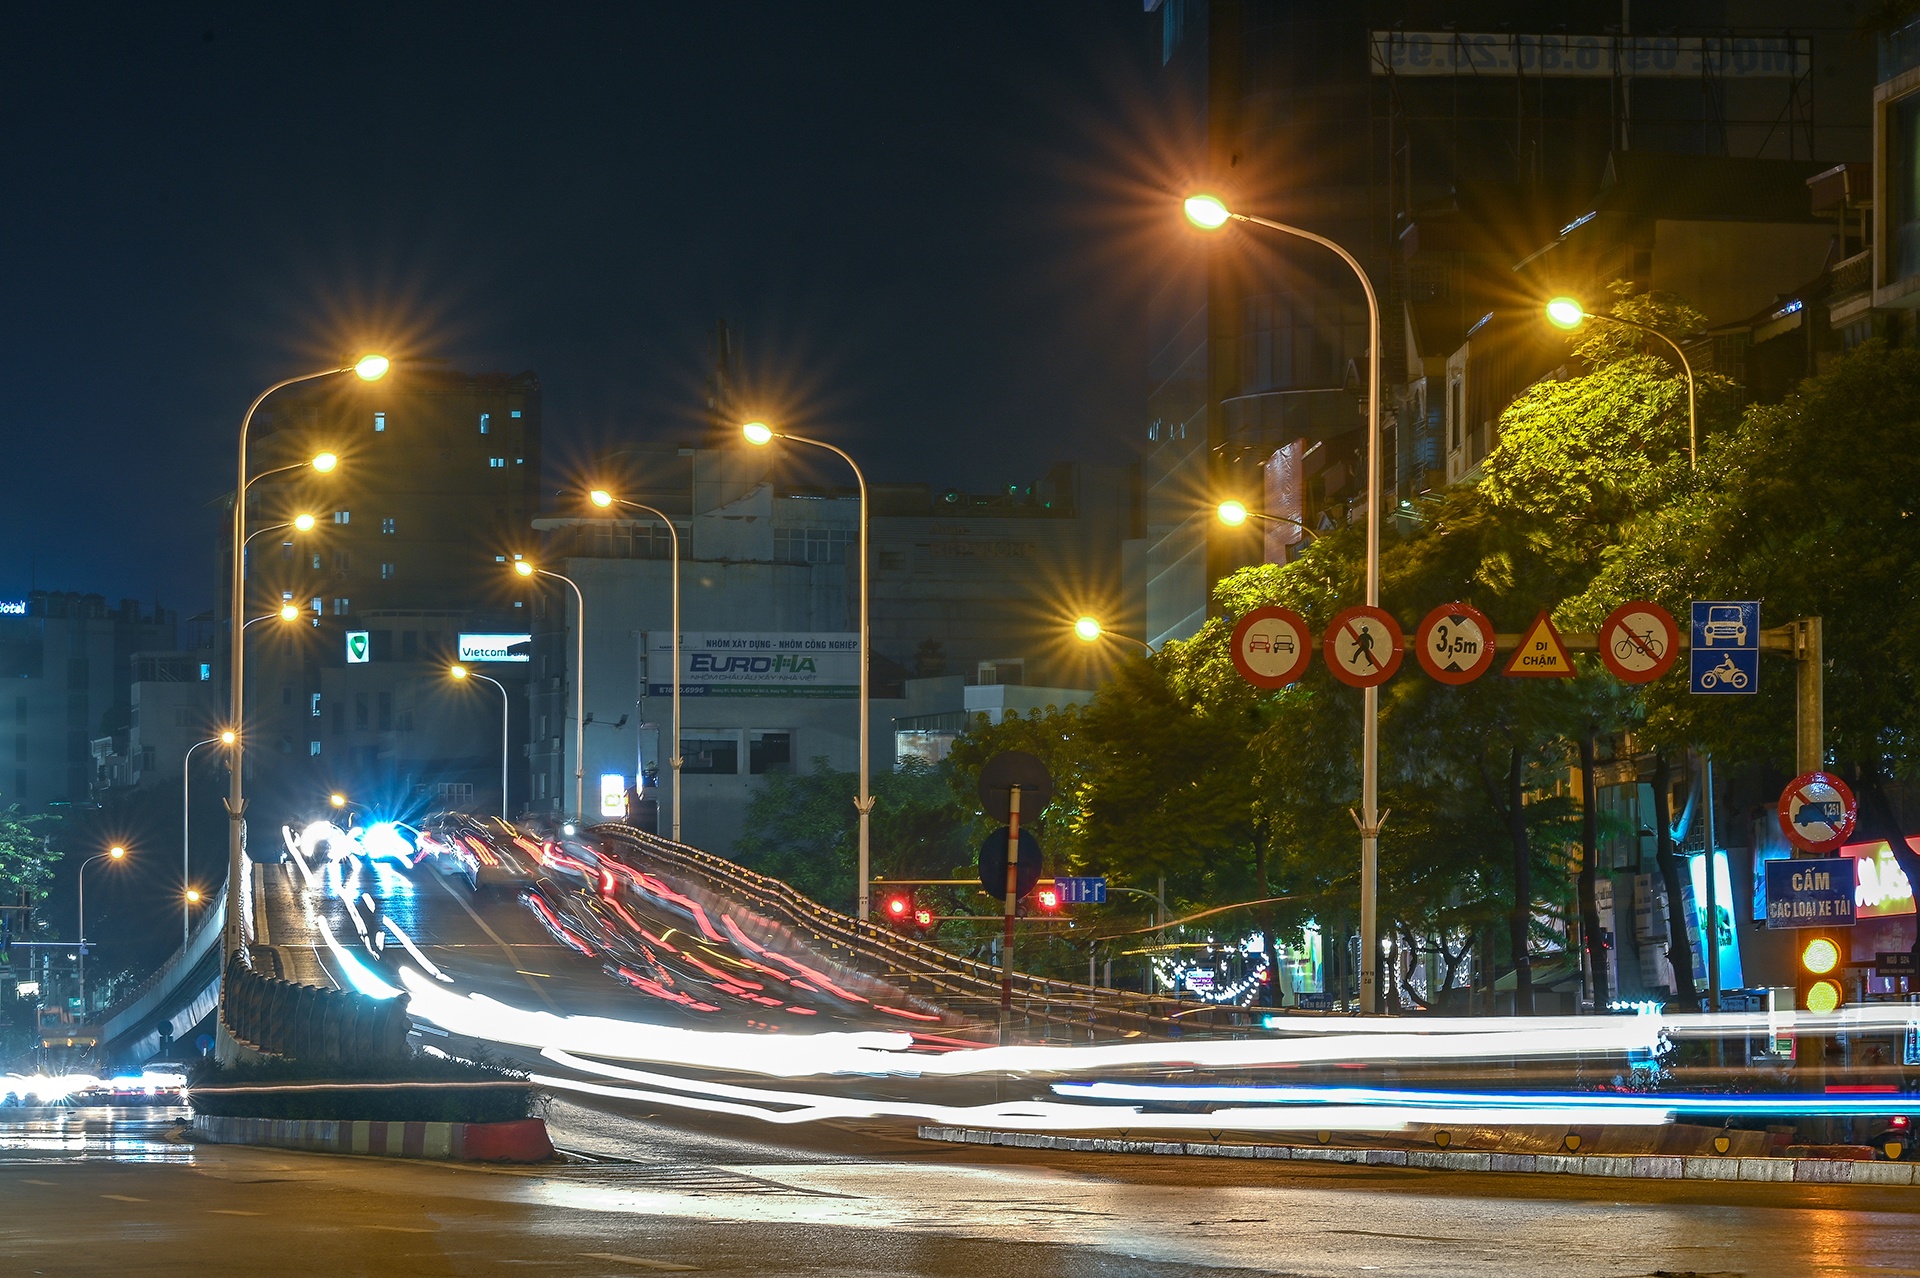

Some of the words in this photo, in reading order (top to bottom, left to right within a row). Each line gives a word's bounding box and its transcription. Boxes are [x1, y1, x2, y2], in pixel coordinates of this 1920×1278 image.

[706, 638, 730, 649] NHÔM
[732, 638, 748, 649] XÂY
[749, 638, 771, 650] DỰNG
[779, 639, 803, 649] NHÔM
[805, 639, 827, 649] CÔNG
[829, 639, 858, 650] NGHIỆP
[1436, 625, 1477, 659] 3,5m
[1535, 642, 1548, 651] ĐI
[1523, 655, 1557, 668] CHẬM
[665, 686, 705, 694] 180.6996
[1792, 866, 1830, 892] CẤM
[1769, 898, 1791, 919] CÁC
[1793, 901, 1816, 920] LOẠI
[1818, 900, 1833, 916] XE
[1834, 895, 1851, 916] TẢI
